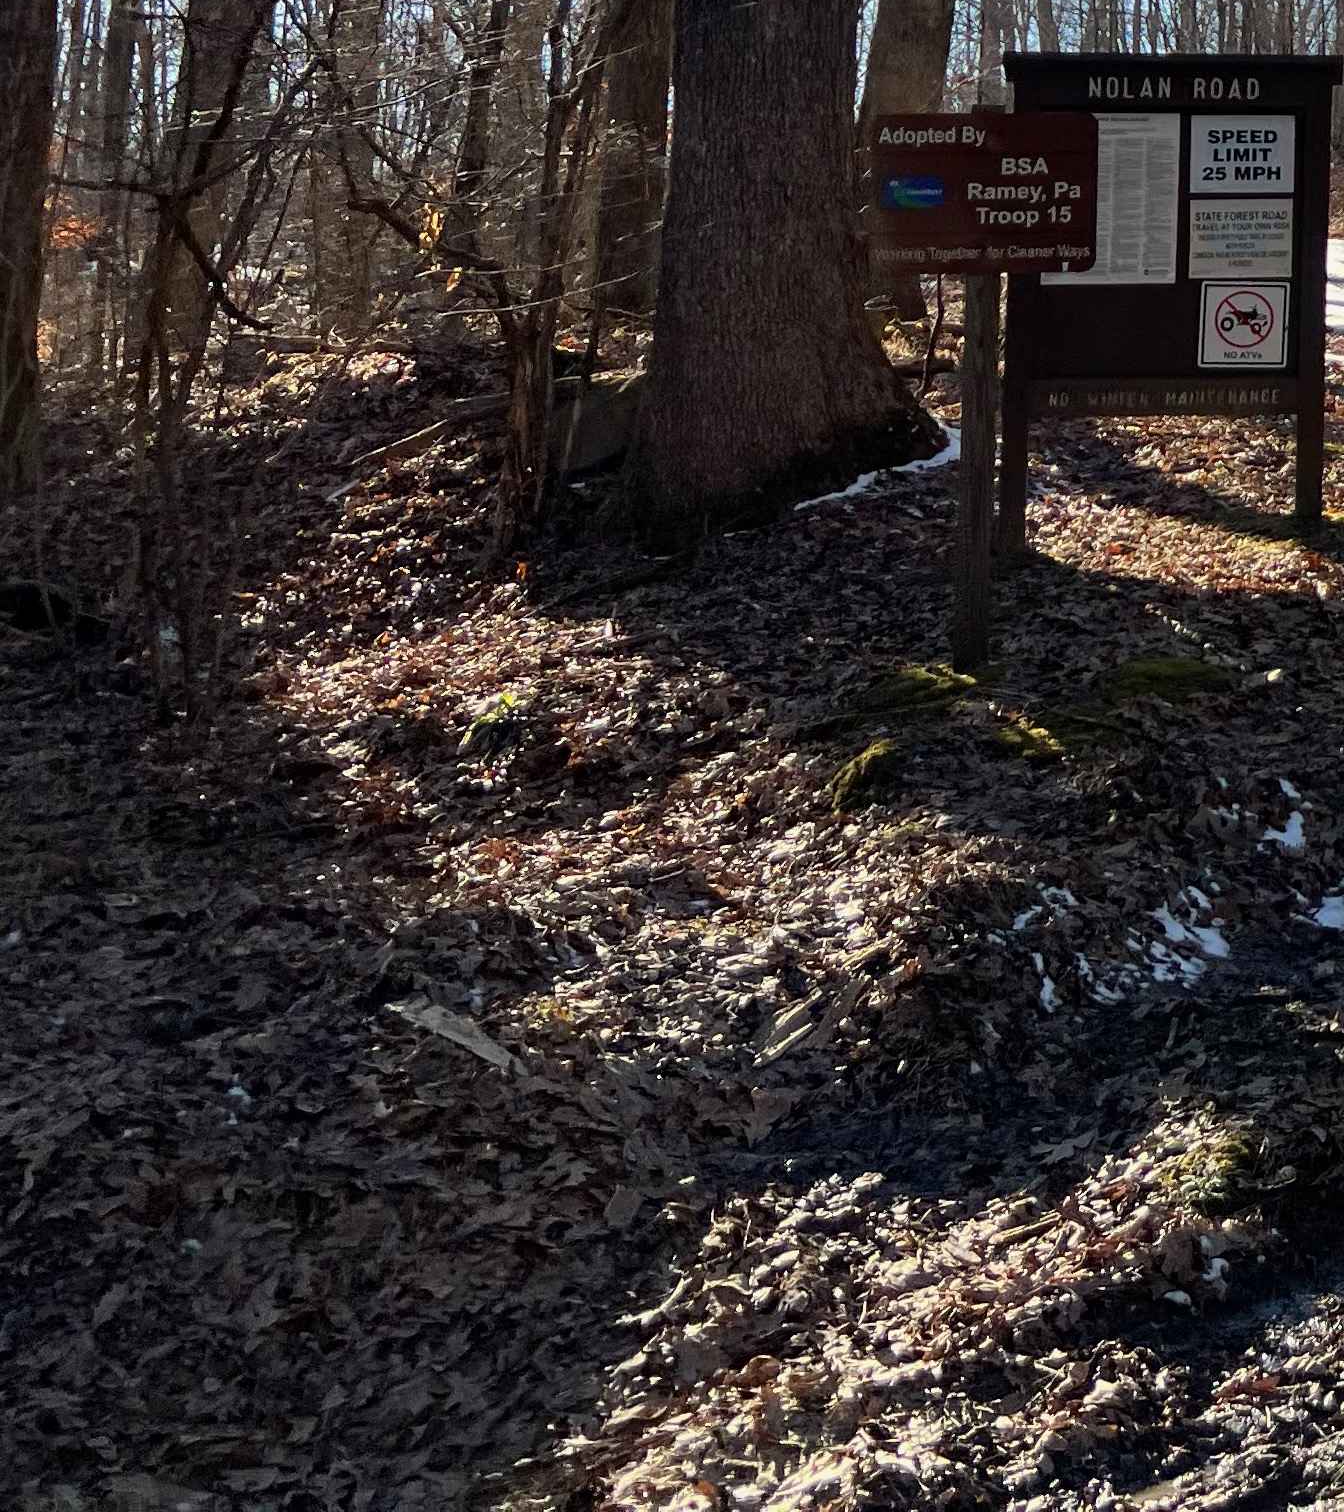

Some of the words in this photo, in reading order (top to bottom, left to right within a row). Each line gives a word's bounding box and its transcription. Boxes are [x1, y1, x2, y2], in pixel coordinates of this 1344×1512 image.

[1088, 76, 1171, 99] NOLAN
[1193, 77, 1260, 100] ROAD
[878, 126, 957, 148] Adopted
[961, 125, 986, 147] By
[1207, 129, 1278, 144] SPEED
[1213, 148, 1273, 162] LIMIT
[1001, 157, 1049, 175] BSA
[1202, 166, 1227, 181] 25
[1234, 166, 1281, 180] MPH
[967, 182, 1047, 203] Ramey,
[1054, 181, 1081, 198] Pa
[976, 206, 1040, 228] Troop
[1047, 205, 1072, 224] 15
[1195, 211, 1224, 221] STATE
[1224, 211, 1258, 221] FOREST
[1262, 210, 1288, 220] ROAD
[1057, 244, 1090, 260] Ways
[1223, 351, 1238, 359] NO
[1240, 351, 1263, 359] ATVs
[1049, 392, 1070, 407] NO
